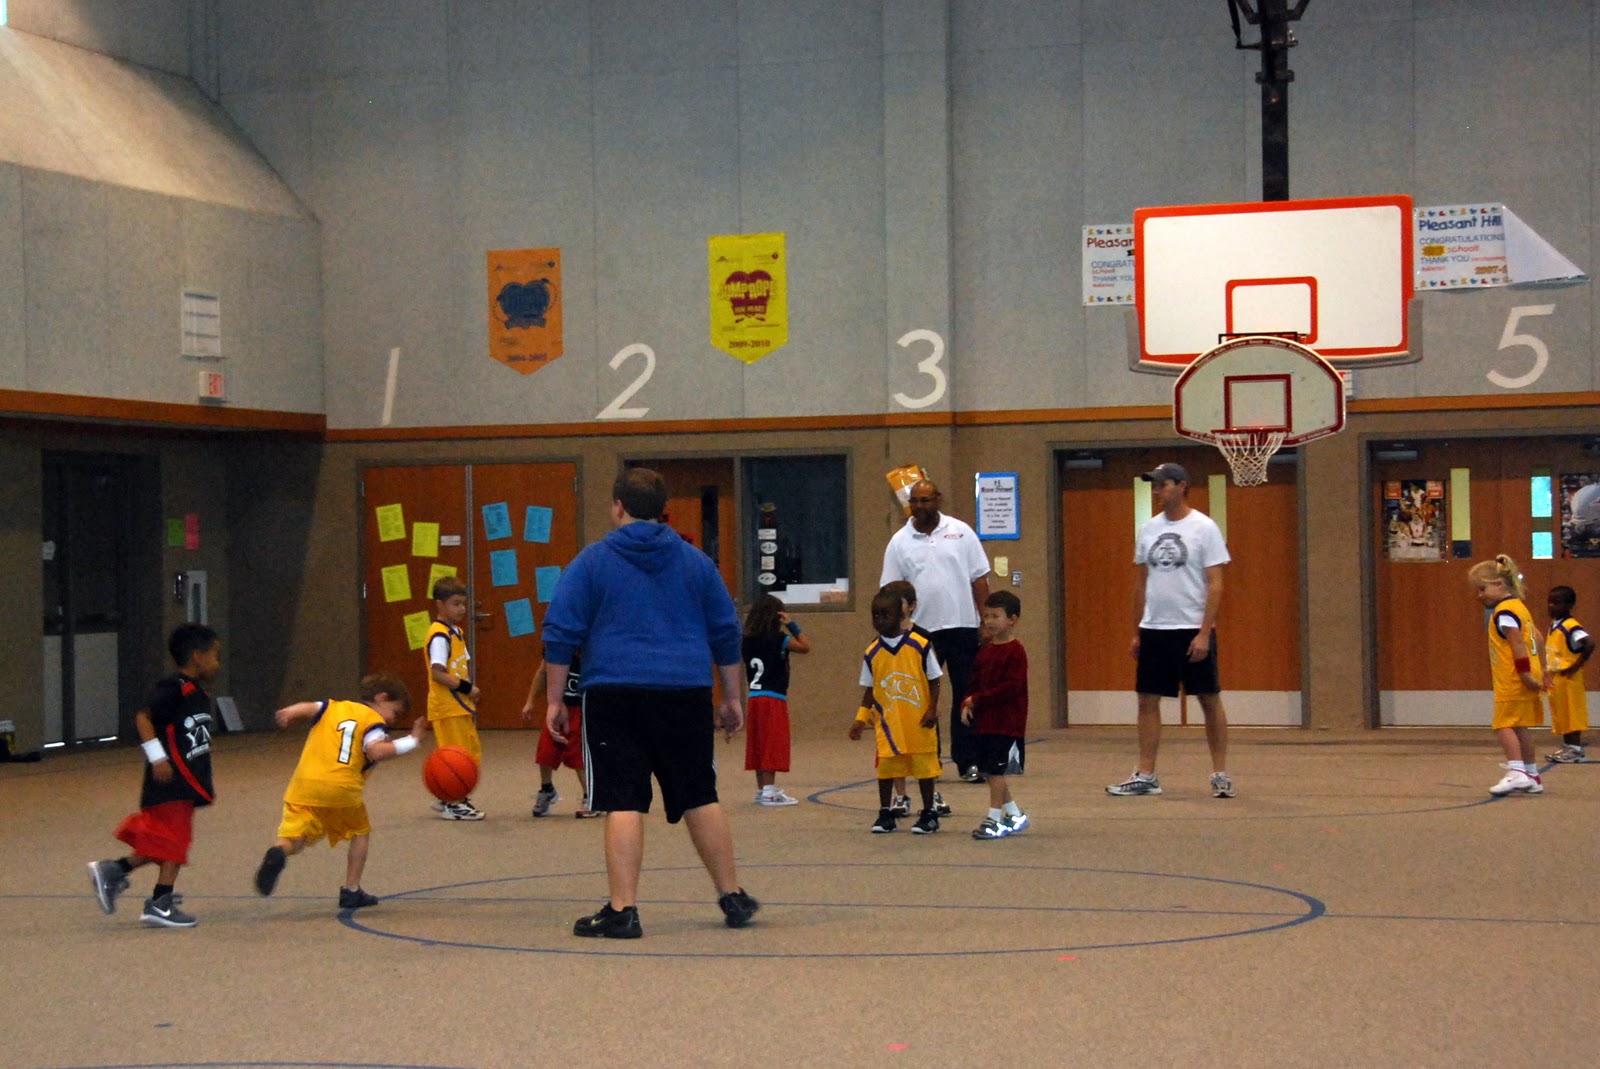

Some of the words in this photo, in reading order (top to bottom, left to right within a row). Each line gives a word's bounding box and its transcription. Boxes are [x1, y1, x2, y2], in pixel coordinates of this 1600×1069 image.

[1419, 216, 1478, 231] Pleasant
[1481, 215, 1502, 228] Hill
[1419, 233, 1505, 245] CONGRATULATIONS
[1420, 256, 1448, 264] THANK
[893, 329, 946, 408] 3
[1486, 304, 1555, 388] 5
[382, 347, 400, 425] 1
[596, 343, 656, 419] 2
[750, 658, 764, 690] 2
[337, 719, 357, 764] 1
